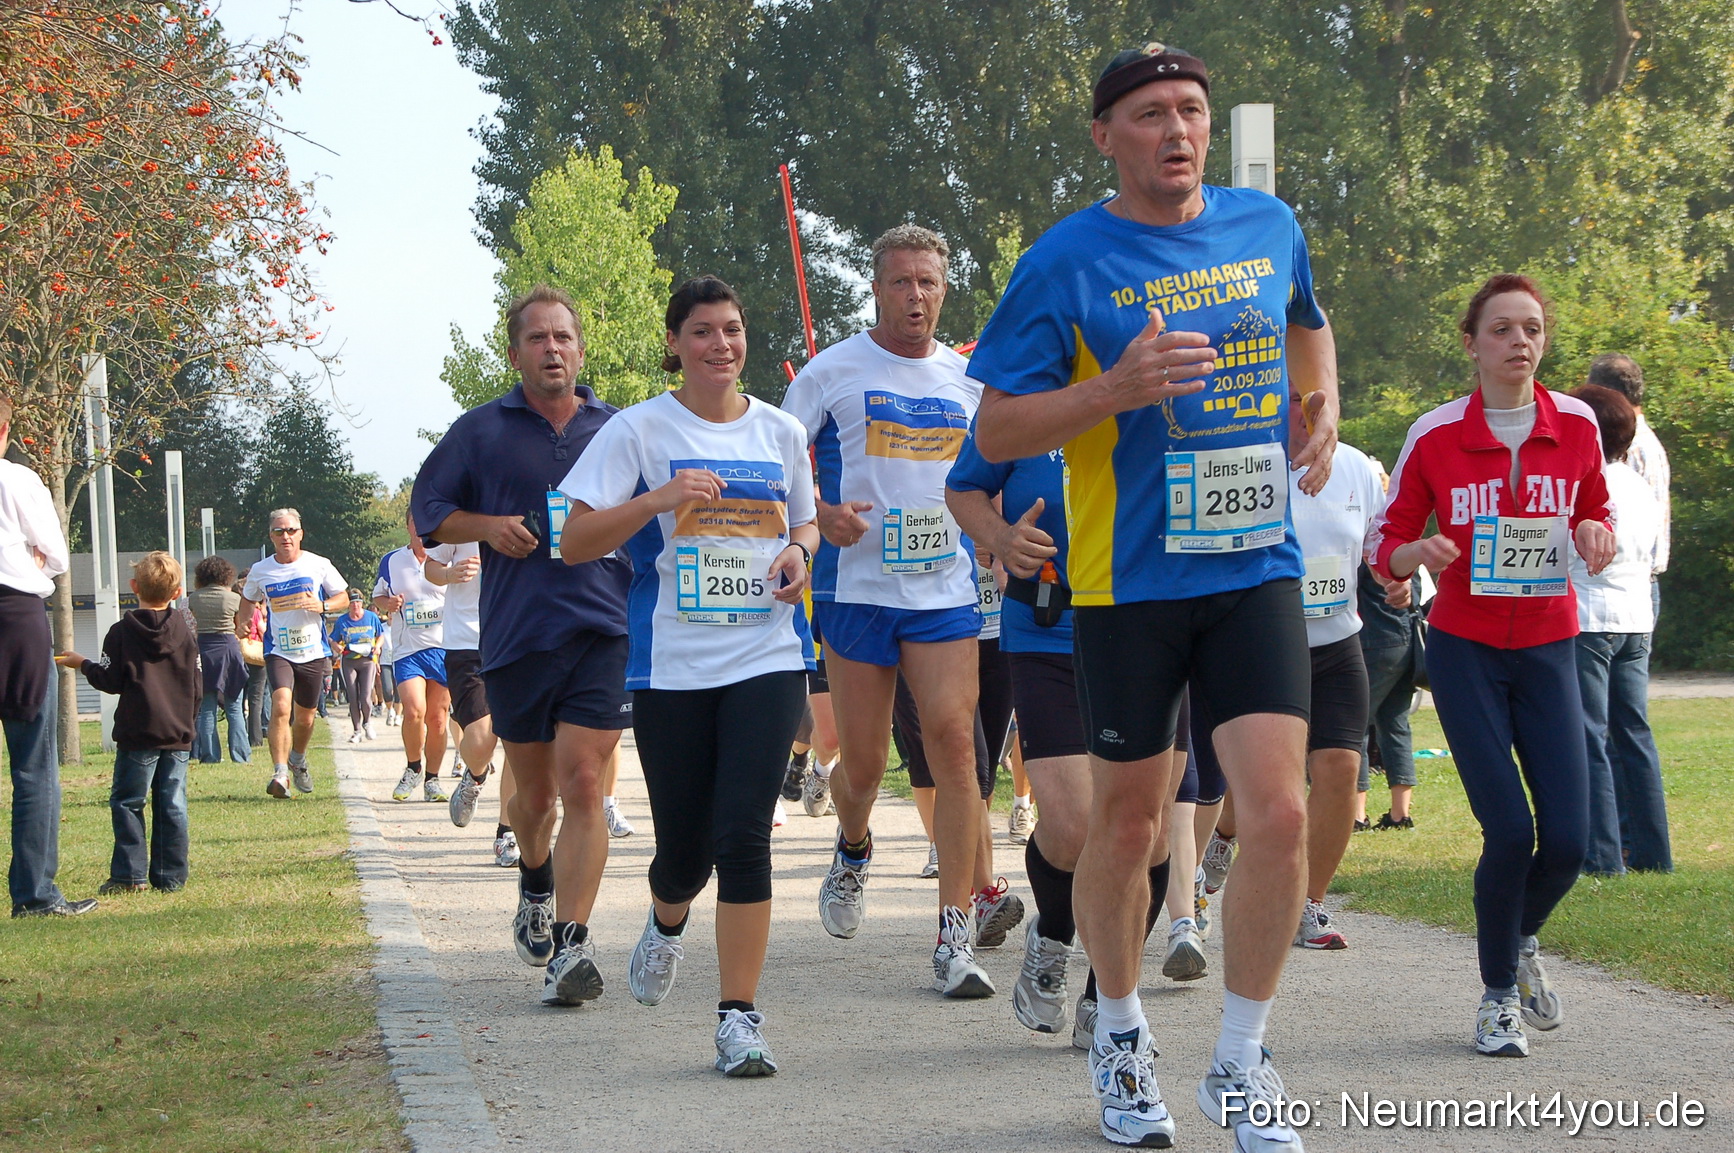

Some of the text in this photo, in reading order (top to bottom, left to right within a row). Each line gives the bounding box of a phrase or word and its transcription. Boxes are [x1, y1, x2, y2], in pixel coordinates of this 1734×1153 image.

[1110, 257, 1276, 308] 10. NEUMARKTER
[1145, 279, 1260, 320] STADTLAUF
[1213, 367, 1282, 393] 20.09.2009
[1203, 455, 1272, 479] Jens-Uwe
[1175, 491, 1183, 505] D
[1205, 484, 1274, 516] 2833
[906, 512, 943, 527] Gerhard
[888, 533, 894, 542] D
[907, 529, 948, 551] 3721
[1504, 524, 1548, 542] Dagmar
[1479, 544, 1486, 556] C
[1502, 547, 1558, 568] 2774
[704, 553, 745, 569] Kerstin
[683, 574, 690, 585] D
[706, 576, 764, 597] 2805
[977, 572, 994, 584] uela
[1308, 578, 1346, 597] 3789
[416, 610, 438, 620] 6168
[290, 634, 311, 645] 3637
